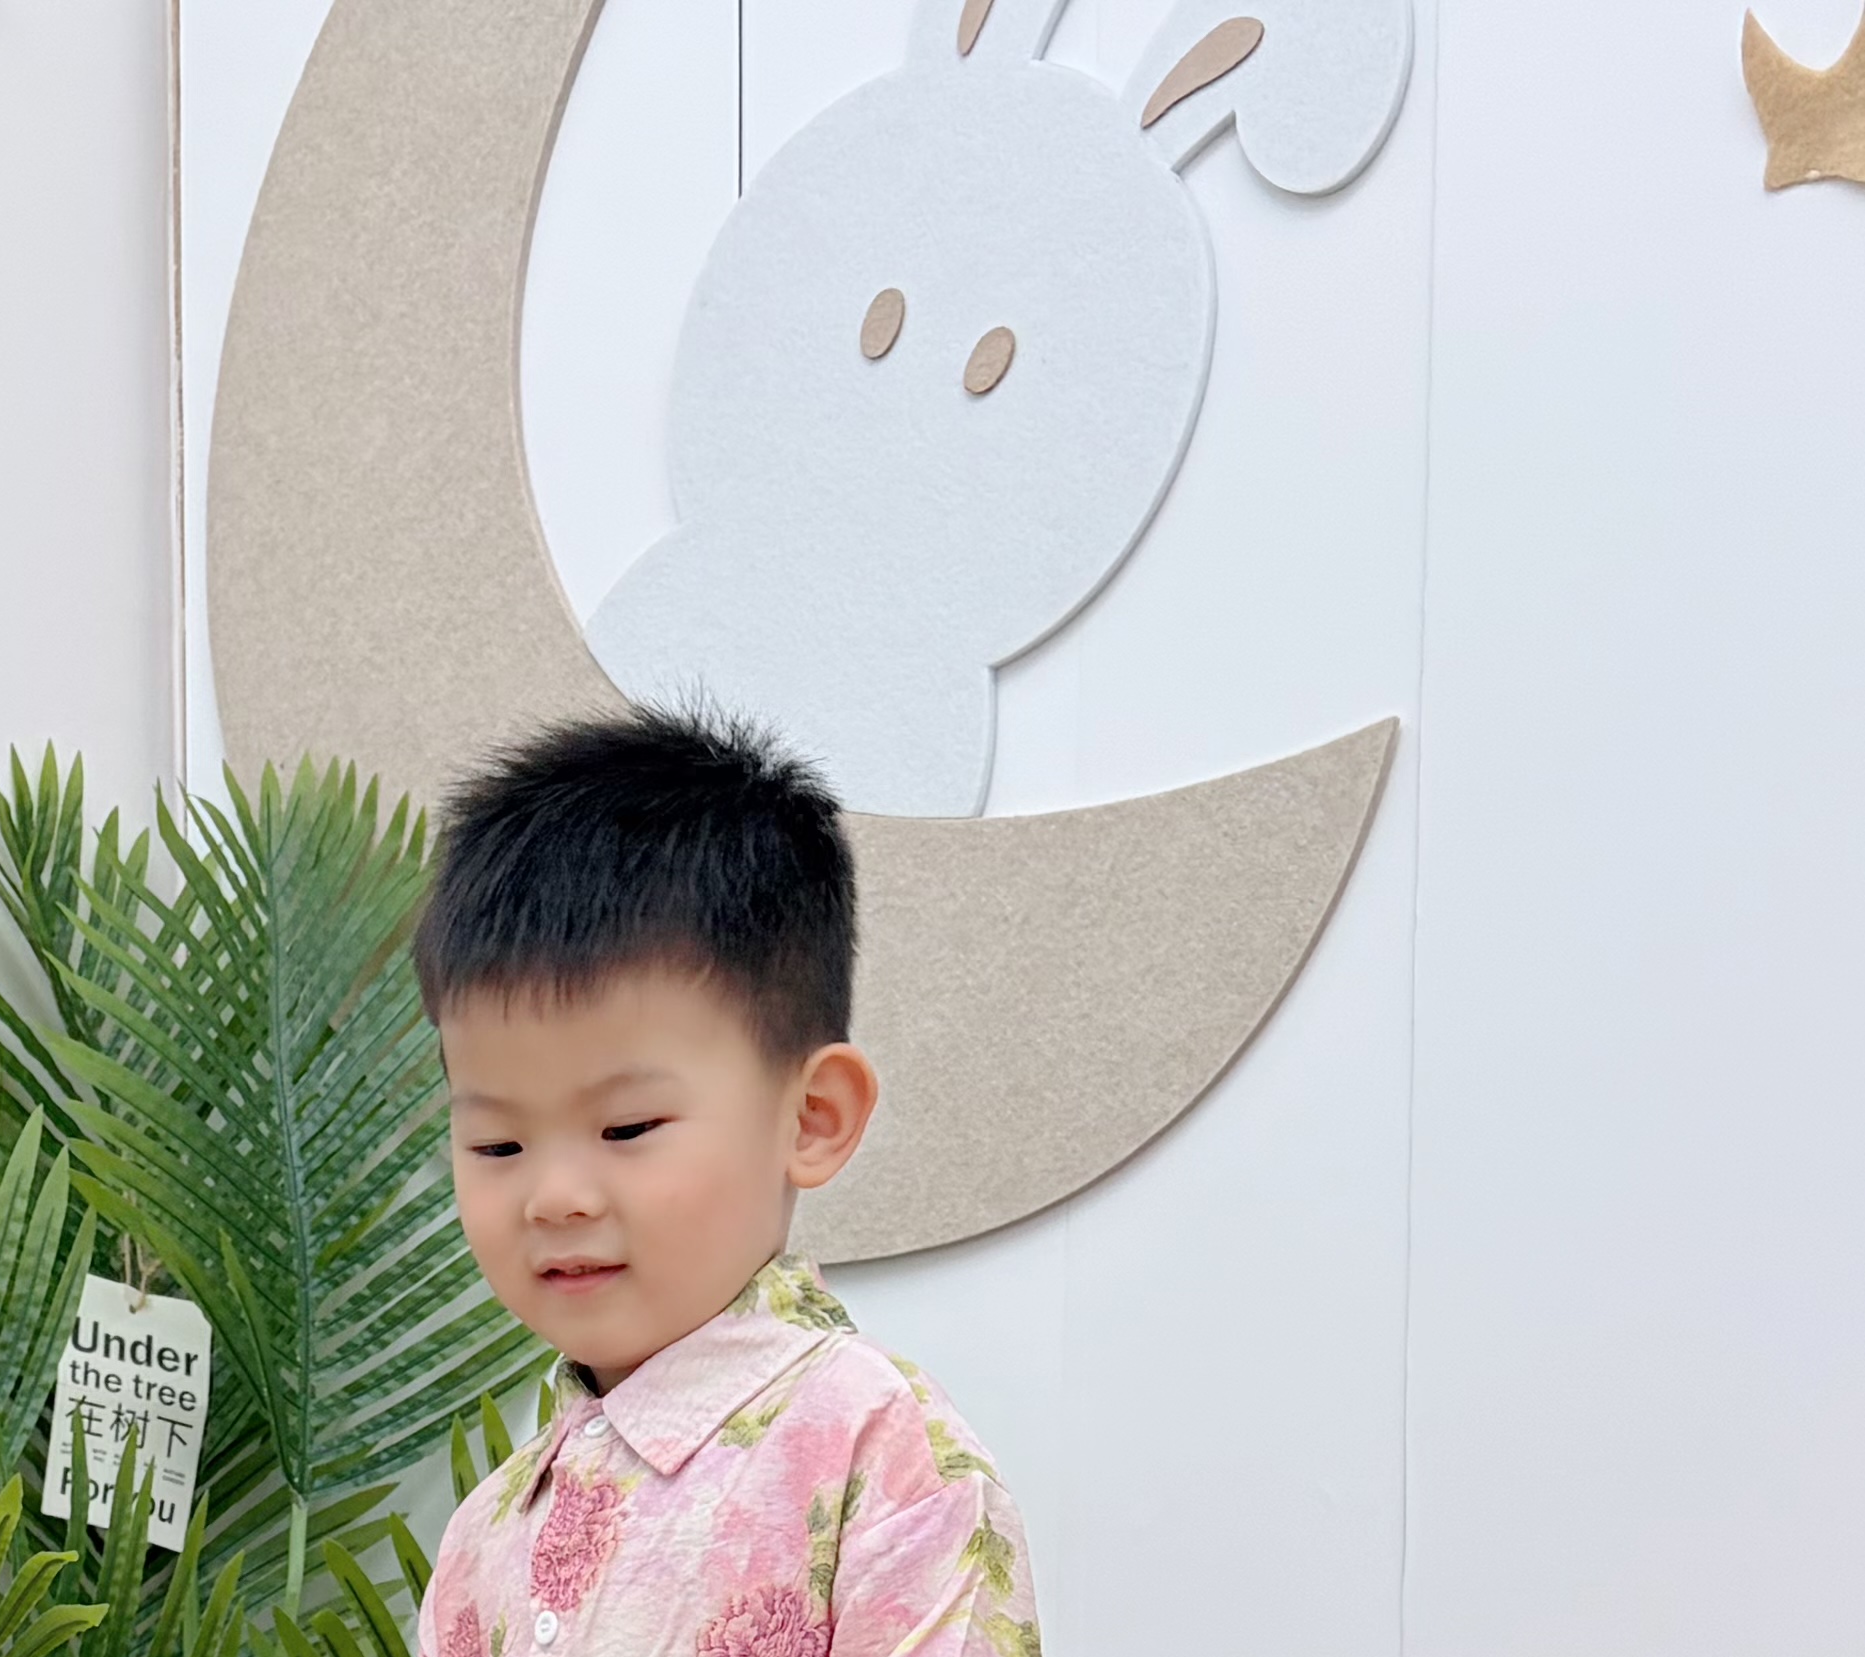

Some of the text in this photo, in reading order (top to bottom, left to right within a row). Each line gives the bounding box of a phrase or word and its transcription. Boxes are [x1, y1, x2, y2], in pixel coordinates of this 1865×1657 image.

[71, 1317, 199, 1377] Under
[68, 1360, 198, 1412] the tree
[65, 1395, 194, 1458] 在树下
